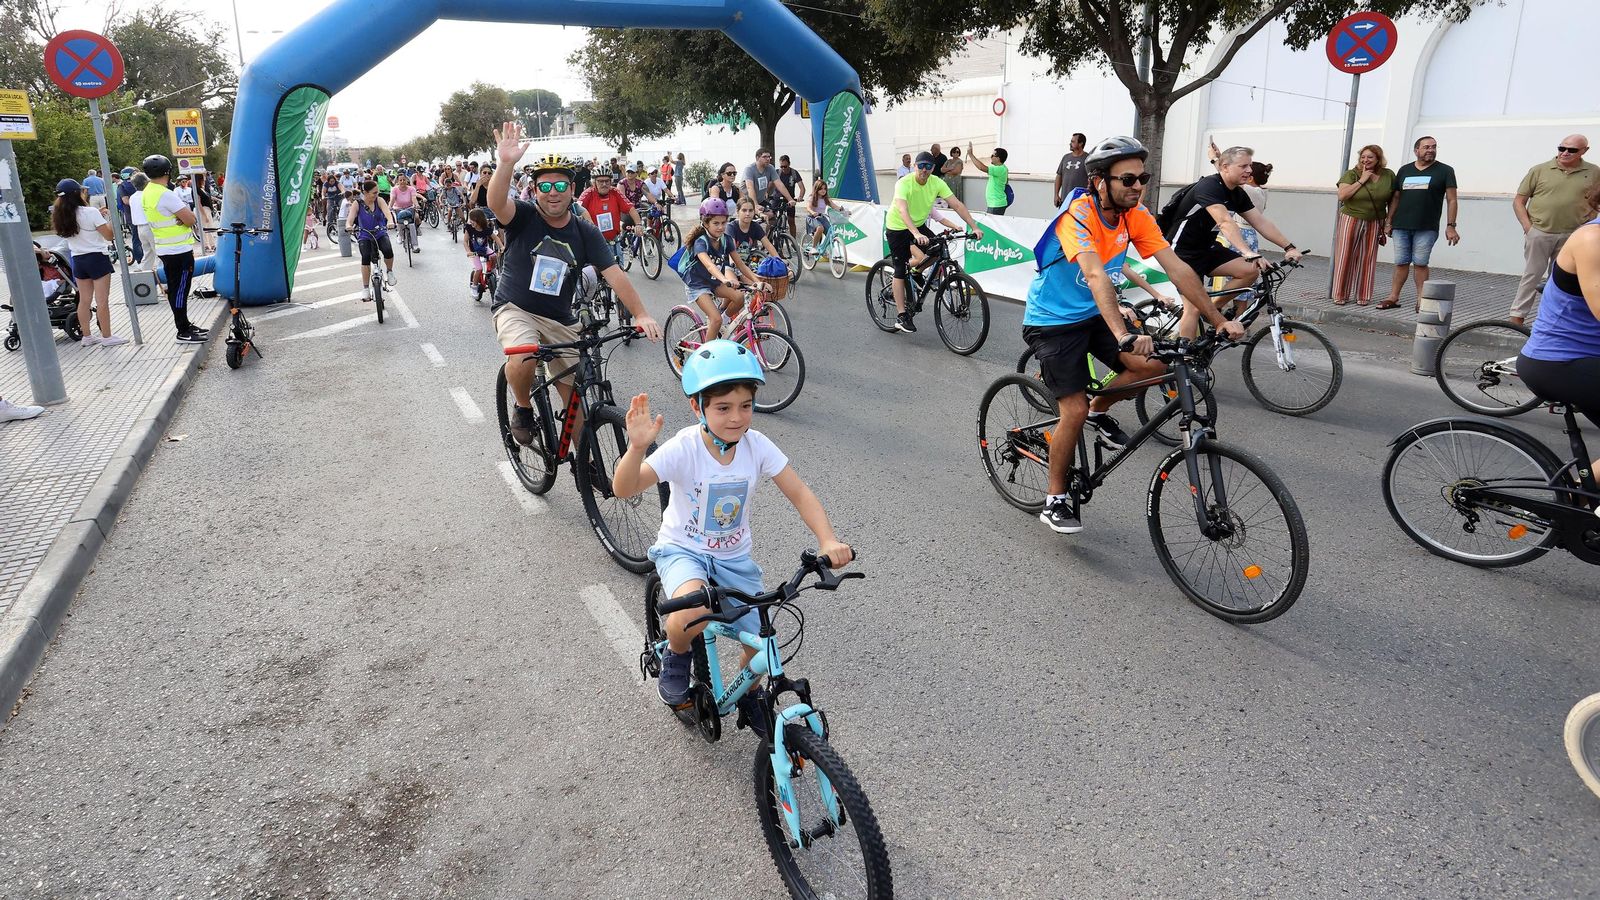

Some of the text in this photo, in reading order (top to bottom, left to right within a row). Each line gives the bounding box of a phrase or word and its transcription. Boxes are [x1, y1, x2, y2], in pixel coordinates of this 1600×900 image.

[834, 105, 855, 147] Inglés
[966, 239, 1023, 262] El Corte Inglés
